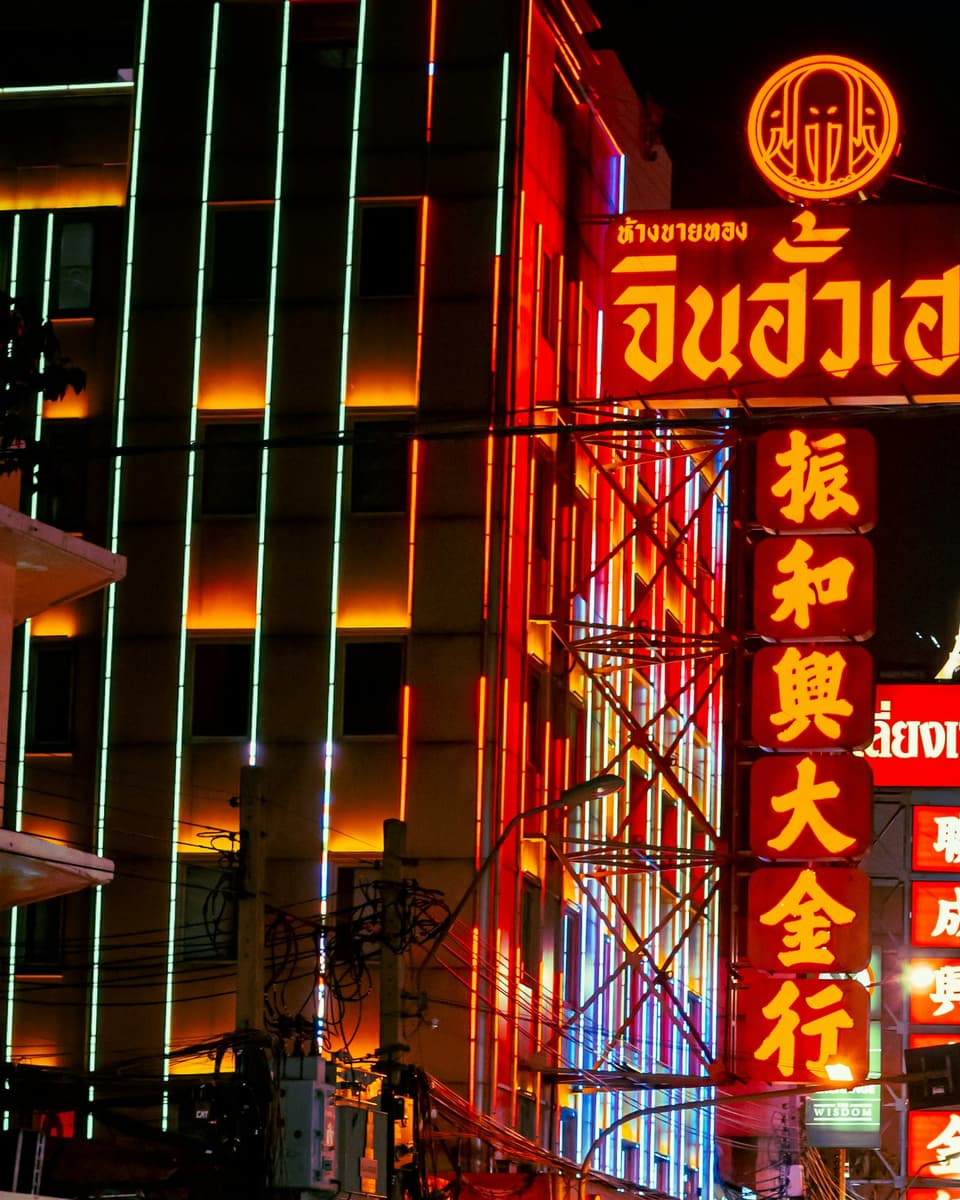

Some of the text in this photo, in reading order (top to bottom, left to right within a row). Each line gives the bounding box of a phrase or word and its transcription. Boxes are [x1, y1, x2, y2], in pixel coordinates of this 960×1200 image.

[617, 217, 748, 245] ห้างขายทอง
[814, 1108, 873, 1117] WISDOM
